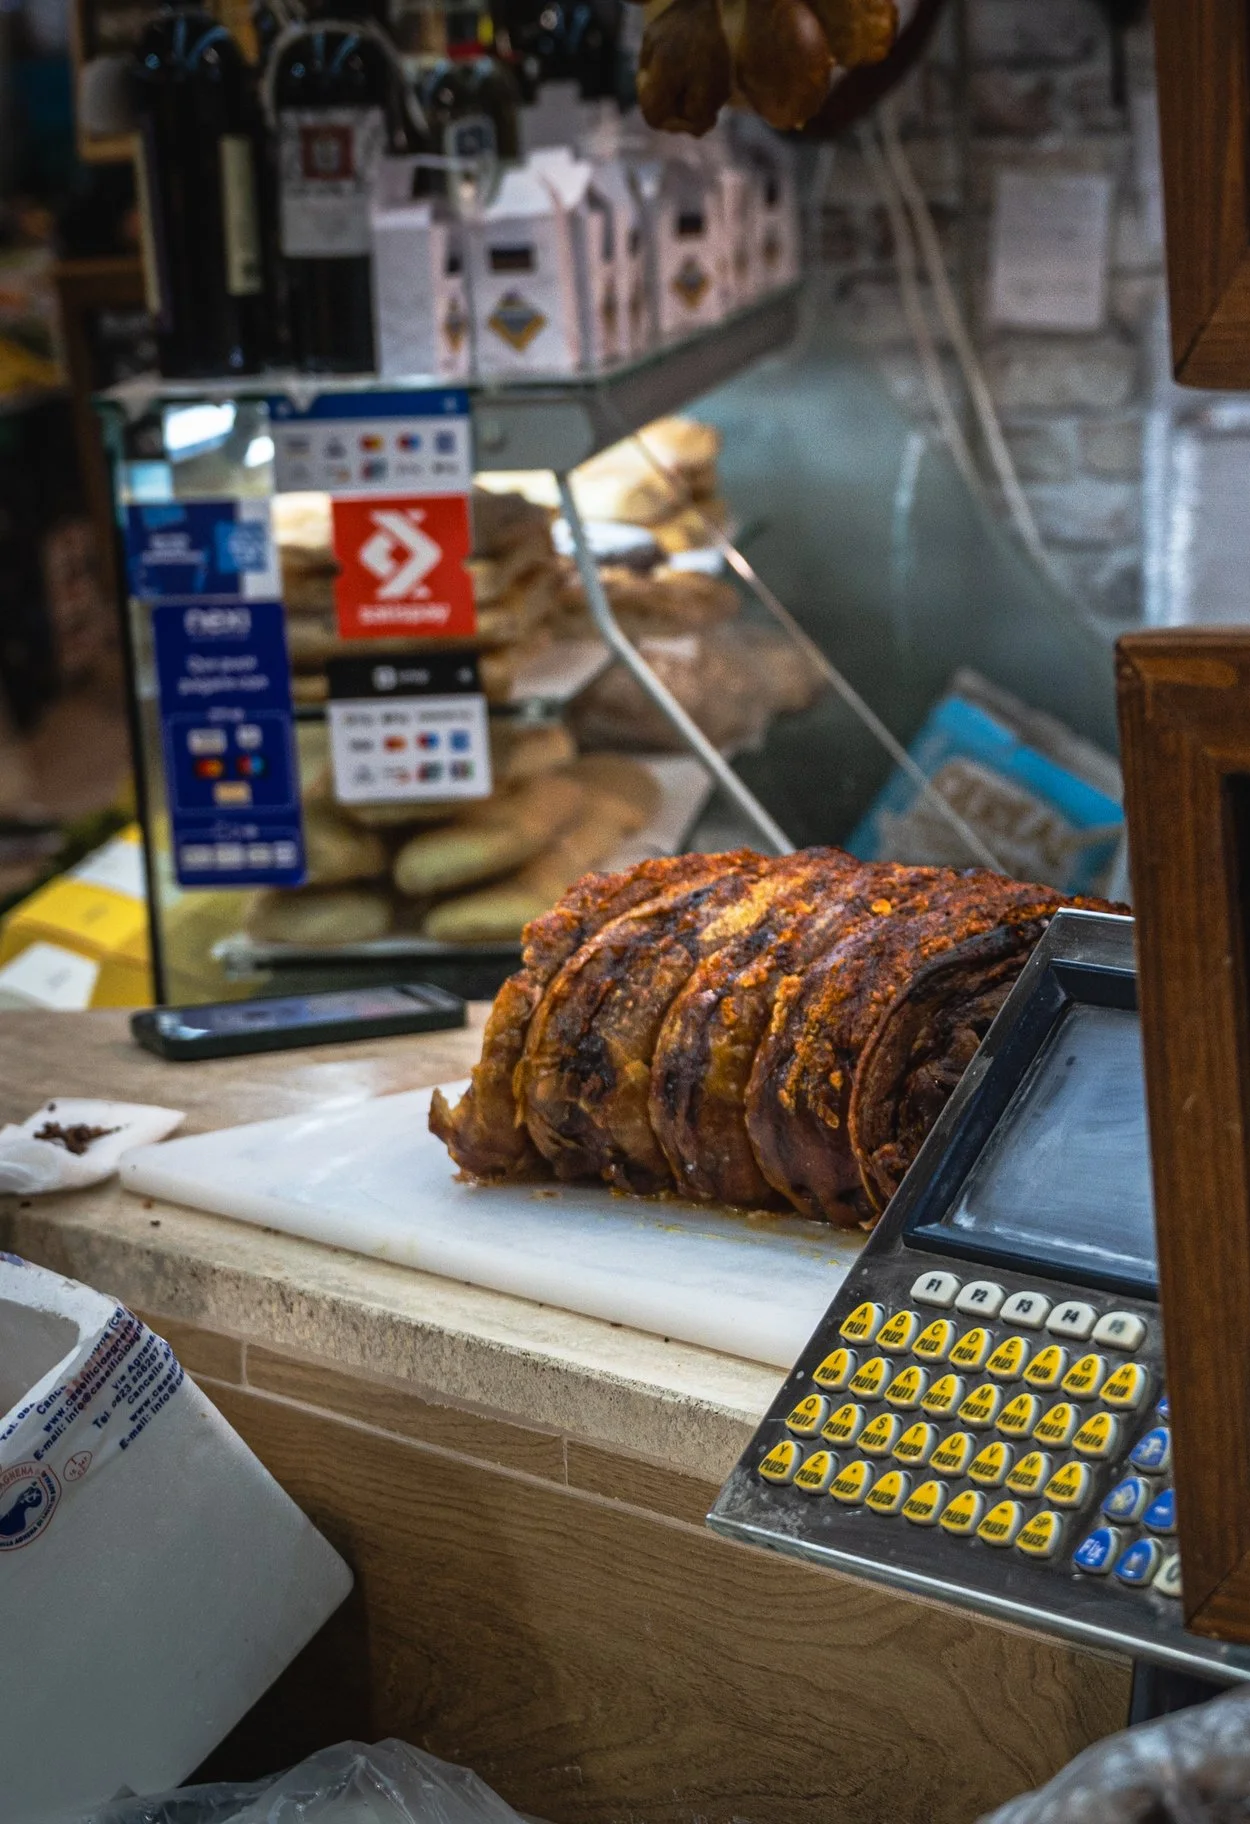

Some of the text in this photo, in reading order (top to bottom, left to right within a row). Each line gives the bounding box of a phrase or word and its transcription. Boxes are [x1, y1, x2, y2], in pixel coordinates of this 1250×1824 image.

[926, 1279, 942, 1292] F1
[971, 1288, 988, 1302] F2
[1015, 1299, 1033, 1313] F3
[1061, 1309, 1080, 1323] F4
[844, 1321, 867, 1335] PLU1
[880, 1329, 904, 1343] PLU2
[916, 1338, 941, 1351] PLU3
[953, 1346, 977, 1361] PLU4
[990, 1355, 1015, 1370] PLU5
[817, 1366, 841, 1380] PLU9
[1027, 1364, 1052, 1379] PLU6
[850, 1375, 879, 1390] PLU10
[1065, 1373, 1091, 1386] PLU7
[887, 1384, 915, 1399] PLU11
[922, 1391, 952, 1407] PLU12
[959, 1401, 990, 1418] PLU13
[997, 1411, 1028, 1428] PLU14
[1035, 1421, 1066, 1438] PLU15
[859, 1431, 887, 1445] PLU19
[895, 1441, 922, 1456] PLU20
[761, 1458, 789, 1474] PLU25
[931, 1451, 961, 1467] PLU21
[796, 1469, 823, 1484] PLU26
[968, 1461, 999, 1477] PLU22
[832, 1479, 860, 1494] PLU27
[942, 1510, 971, 1525] PLU30
[1034, 1517, 1051, 1528] SP
[1018, 1530, 1049, 1547] PLU32
